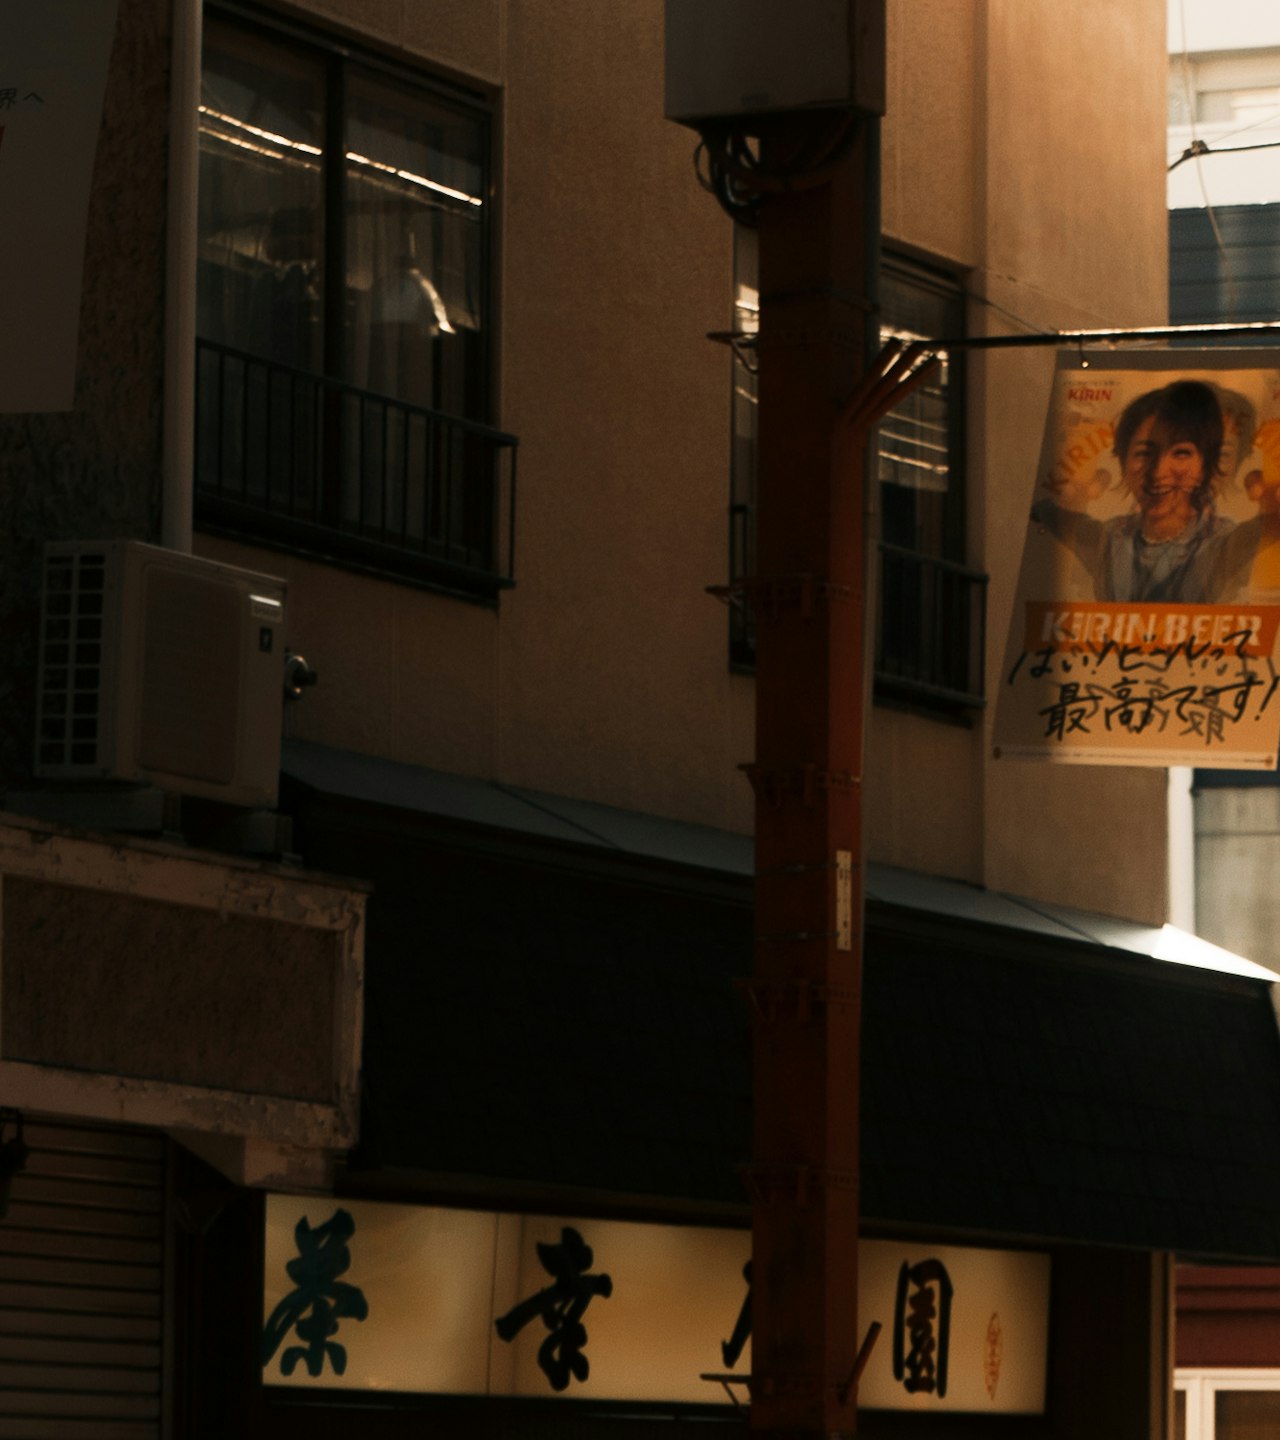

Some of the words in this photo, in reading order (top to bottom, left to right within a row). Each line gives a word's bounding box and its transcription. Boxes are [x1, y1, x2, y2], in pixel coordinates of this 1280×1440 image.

[1067, 388, 1113, 402] KIRIN
[1041, 610, 1157, 645] KIRIN
[1161, 613, 1262, 646] BEER
